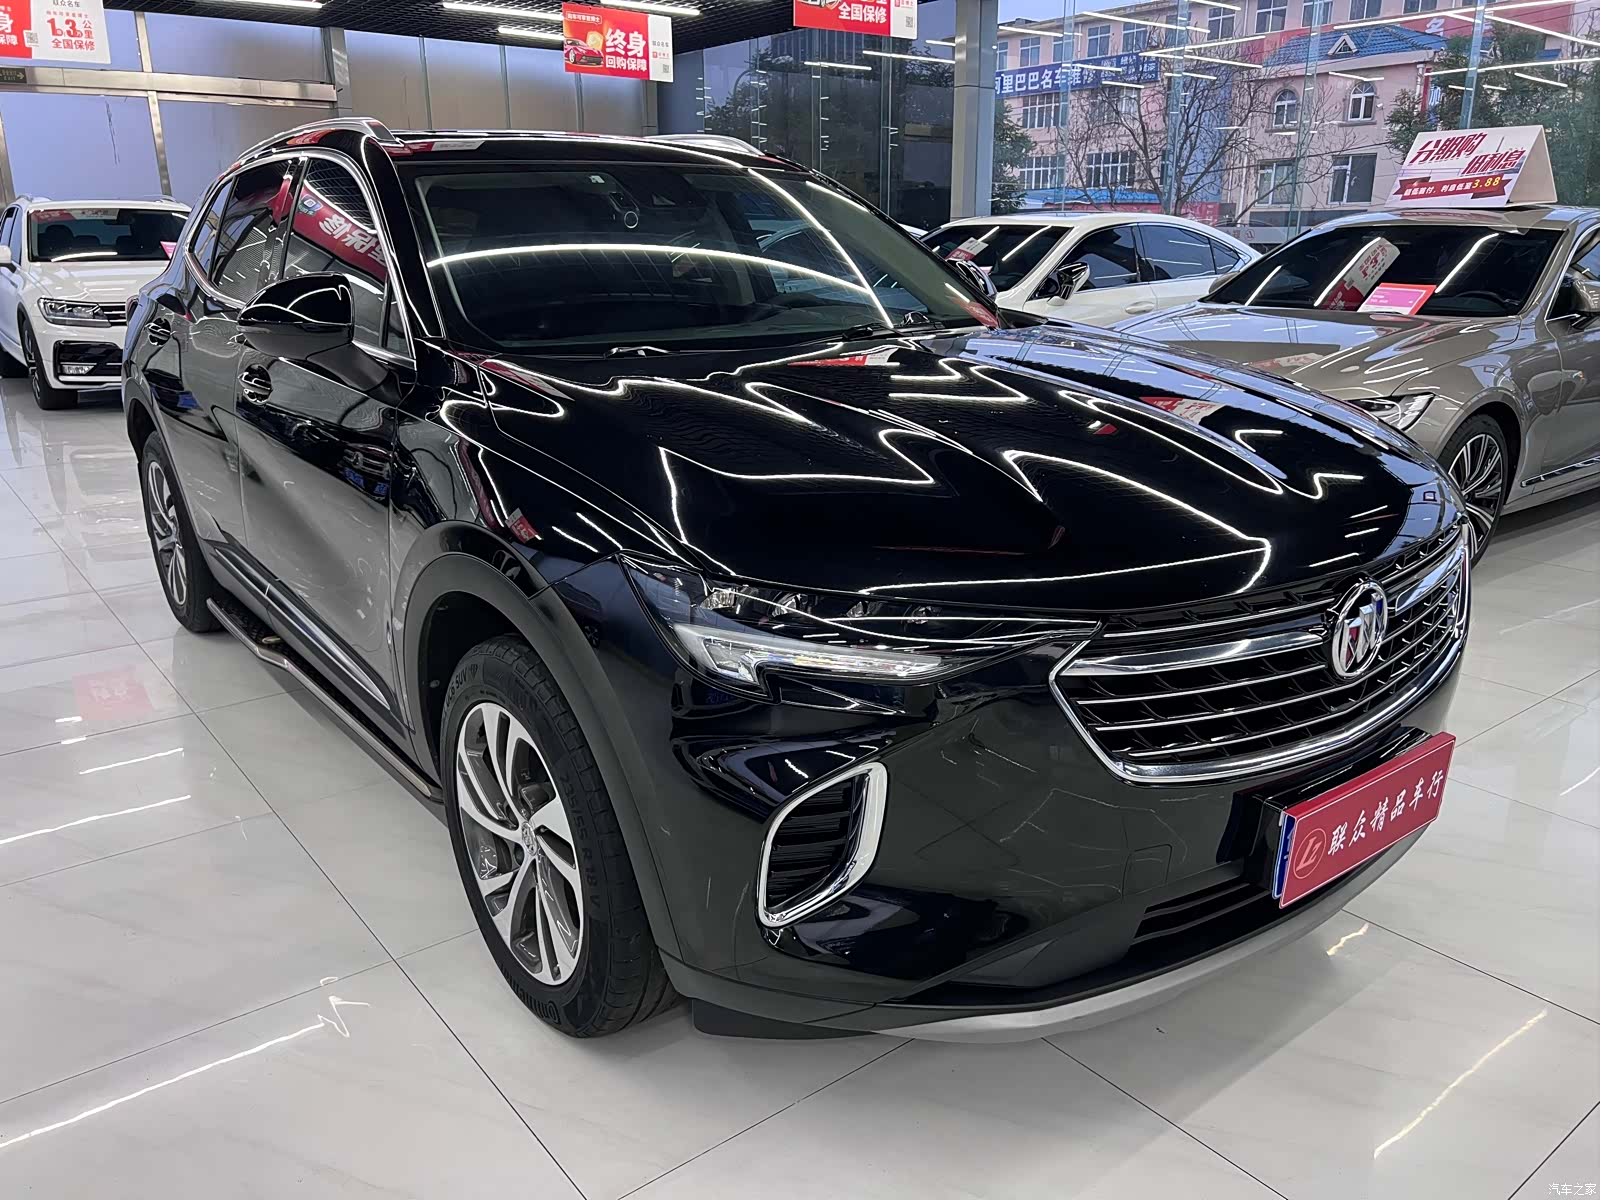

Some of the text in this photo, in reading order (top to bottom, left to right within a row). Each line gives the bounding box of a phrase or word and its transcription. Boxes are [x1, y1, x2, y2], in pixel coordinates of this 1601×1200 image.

[838, 3, 887, 24] 全国保修
[52, 38, 95, 51] 全国保修
[605, 28, 646, 57] 终身
[605, 56, 648, 71] 回购保障
[1409, 132, 1488, 164] 分期购
[1461, 149, 1526, 175] 低利息
[1327, 769, 1444, 856] 联众精品车行
